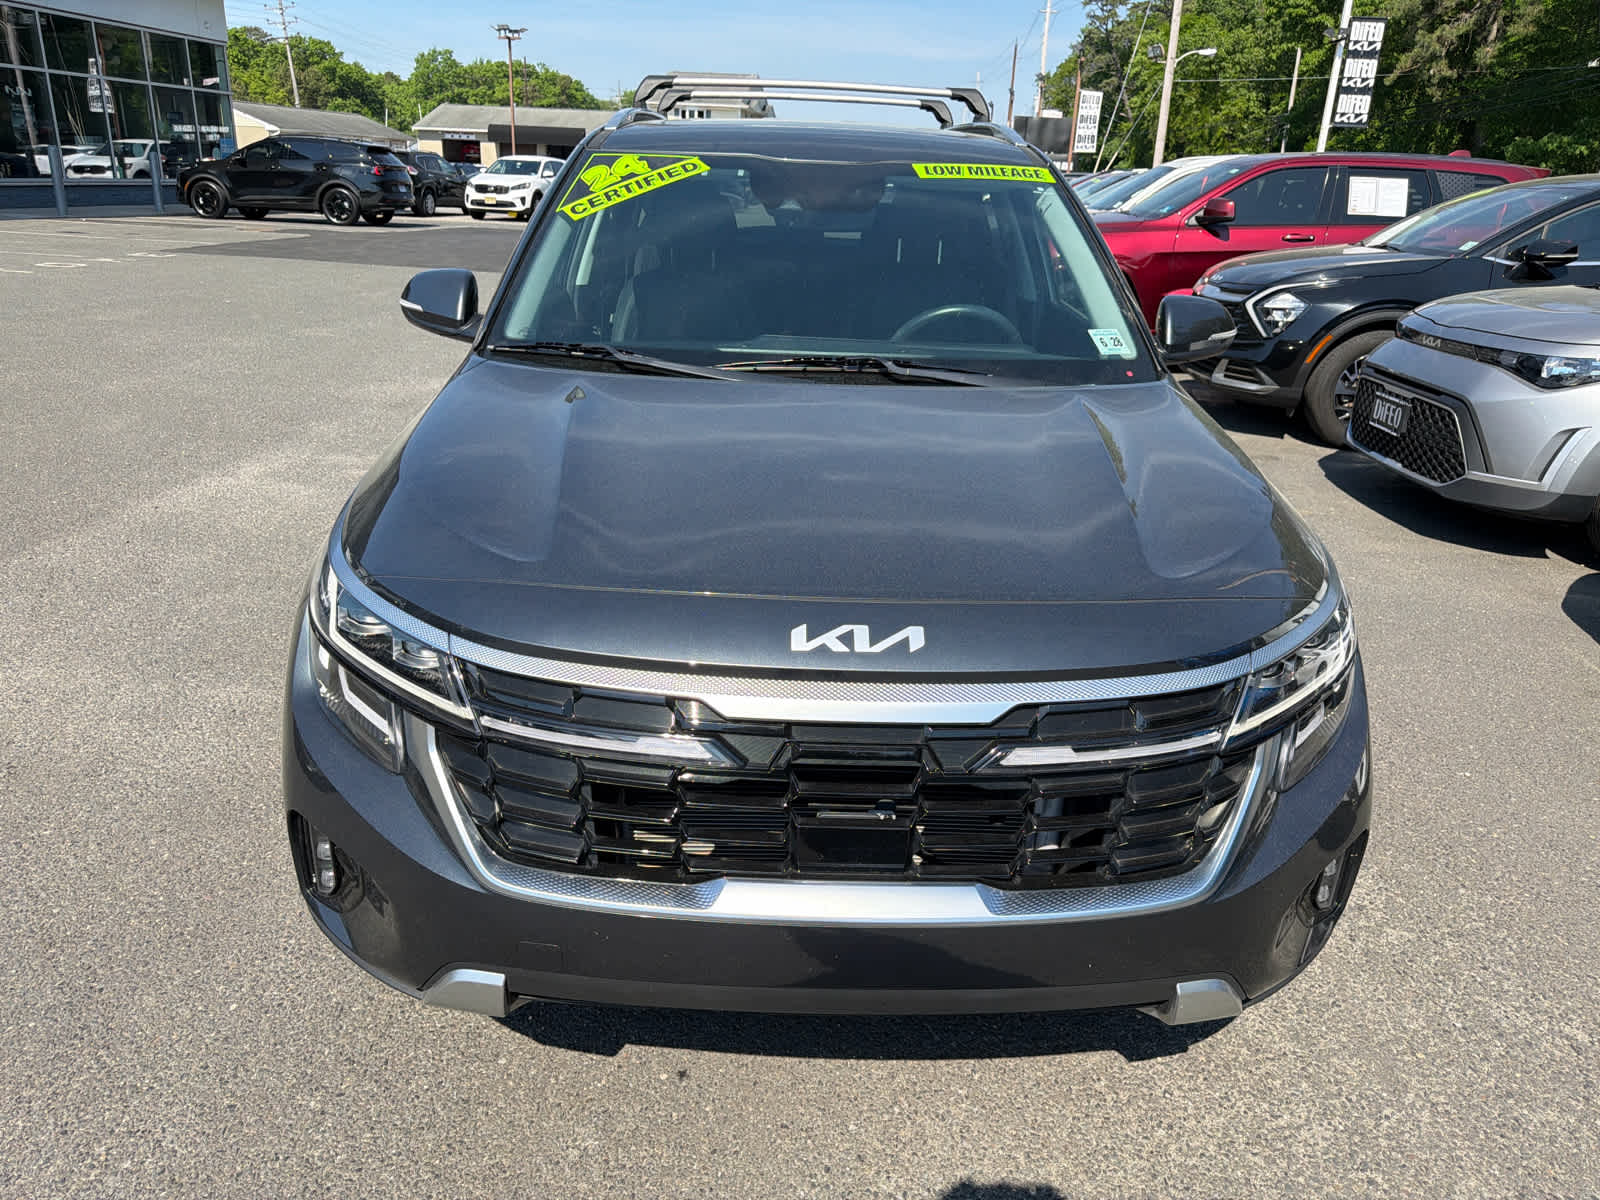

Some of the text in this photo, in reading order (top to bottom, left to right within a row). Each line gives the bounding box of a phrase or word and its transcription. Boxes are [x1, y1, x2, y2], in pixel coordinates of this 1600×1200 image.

[569, 162, 699, 216] CERTIFIED
[580, 154, 653, 193] 24
[924, 165, 1044, 180] LOW MILEAGE
[790, 623, 925, 653] KIA
